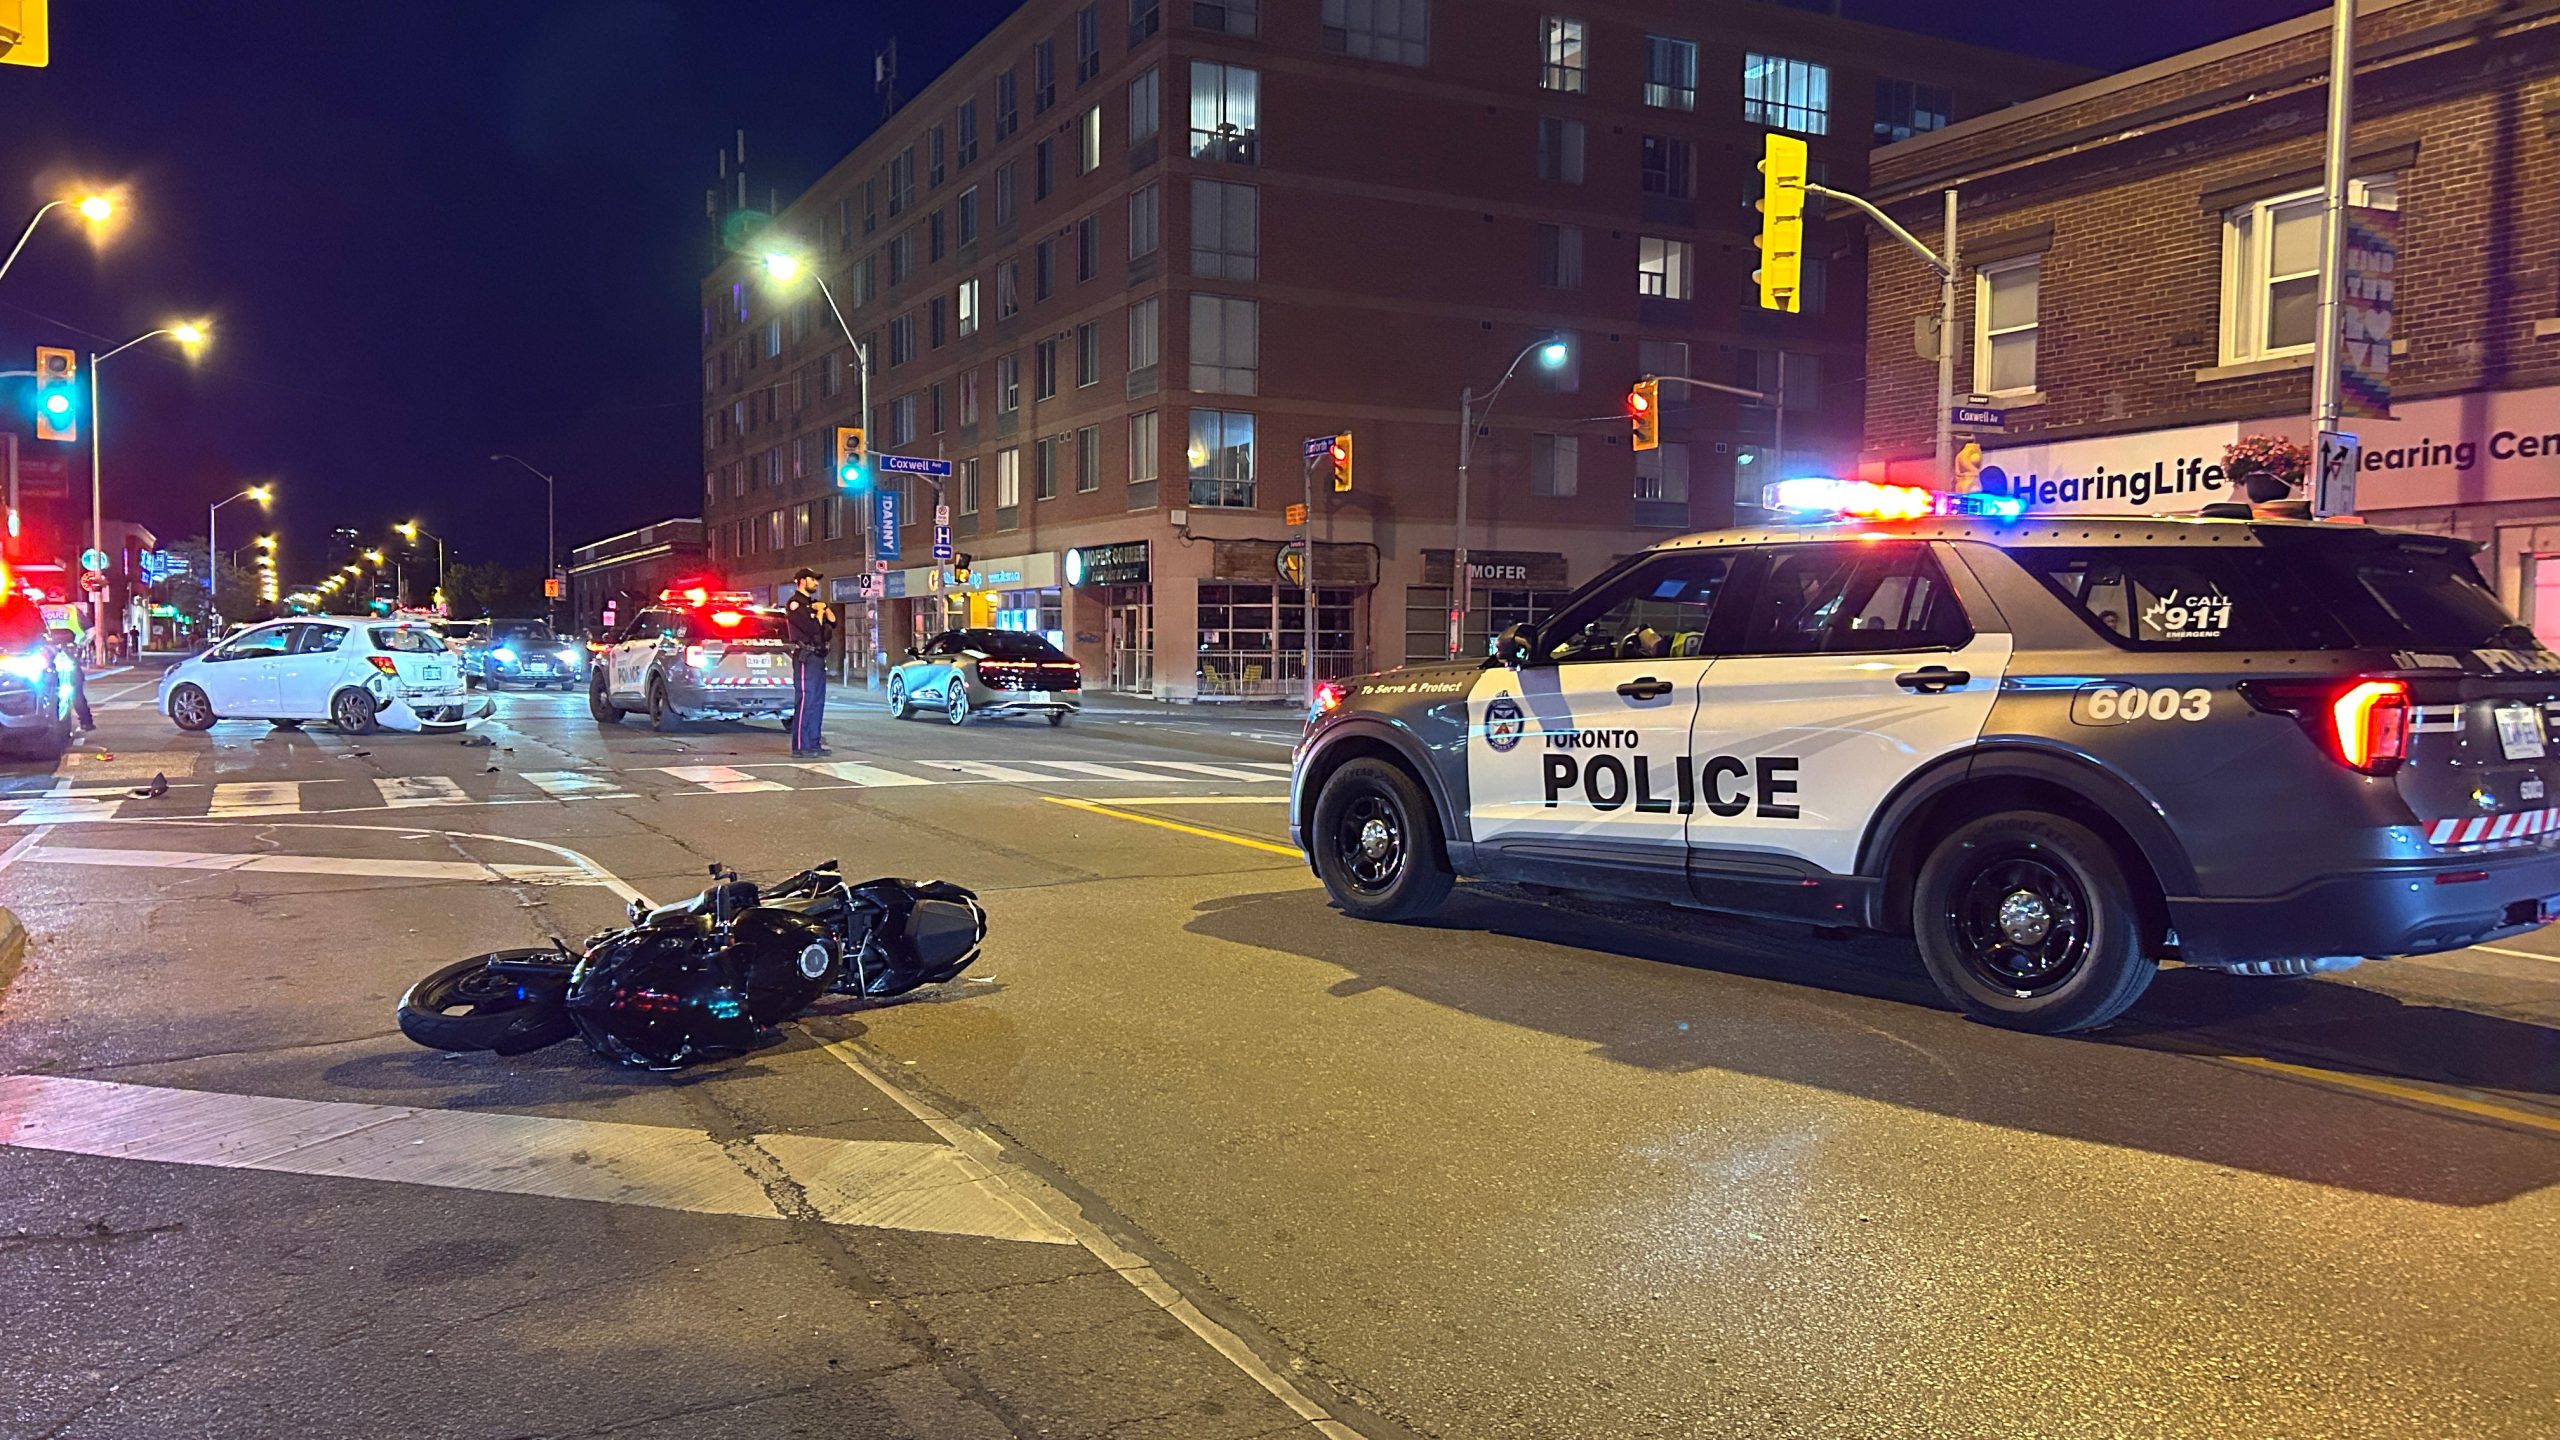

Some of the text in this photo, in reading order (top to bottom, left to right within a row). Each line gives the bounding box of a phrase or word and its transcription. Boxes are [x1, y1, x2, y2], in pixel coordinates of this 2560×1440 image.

[1960, 410, 1989, 423] Coxwell
[2489, 431, 2560, 459] Cen
[889, 458, 929, 471] Coxwell
[2014, 458, 2224, 505] HearingLife
[883, 500, 894, 550] DANNY
[938, 527, 949, 545] H
[1471, 564, 1526, 579] MOFER
[2185, 596, 2232, 606] CALL
[2164, 607, 2231, 630] 9-1-1
[1361, 682, 1462, 695] To Serve & Protect
[2088, 688, 2211, 721] 6003
[1543, 730, 1639, 748] TORONTO
[1543, 753, 1800, 819] POLICE
